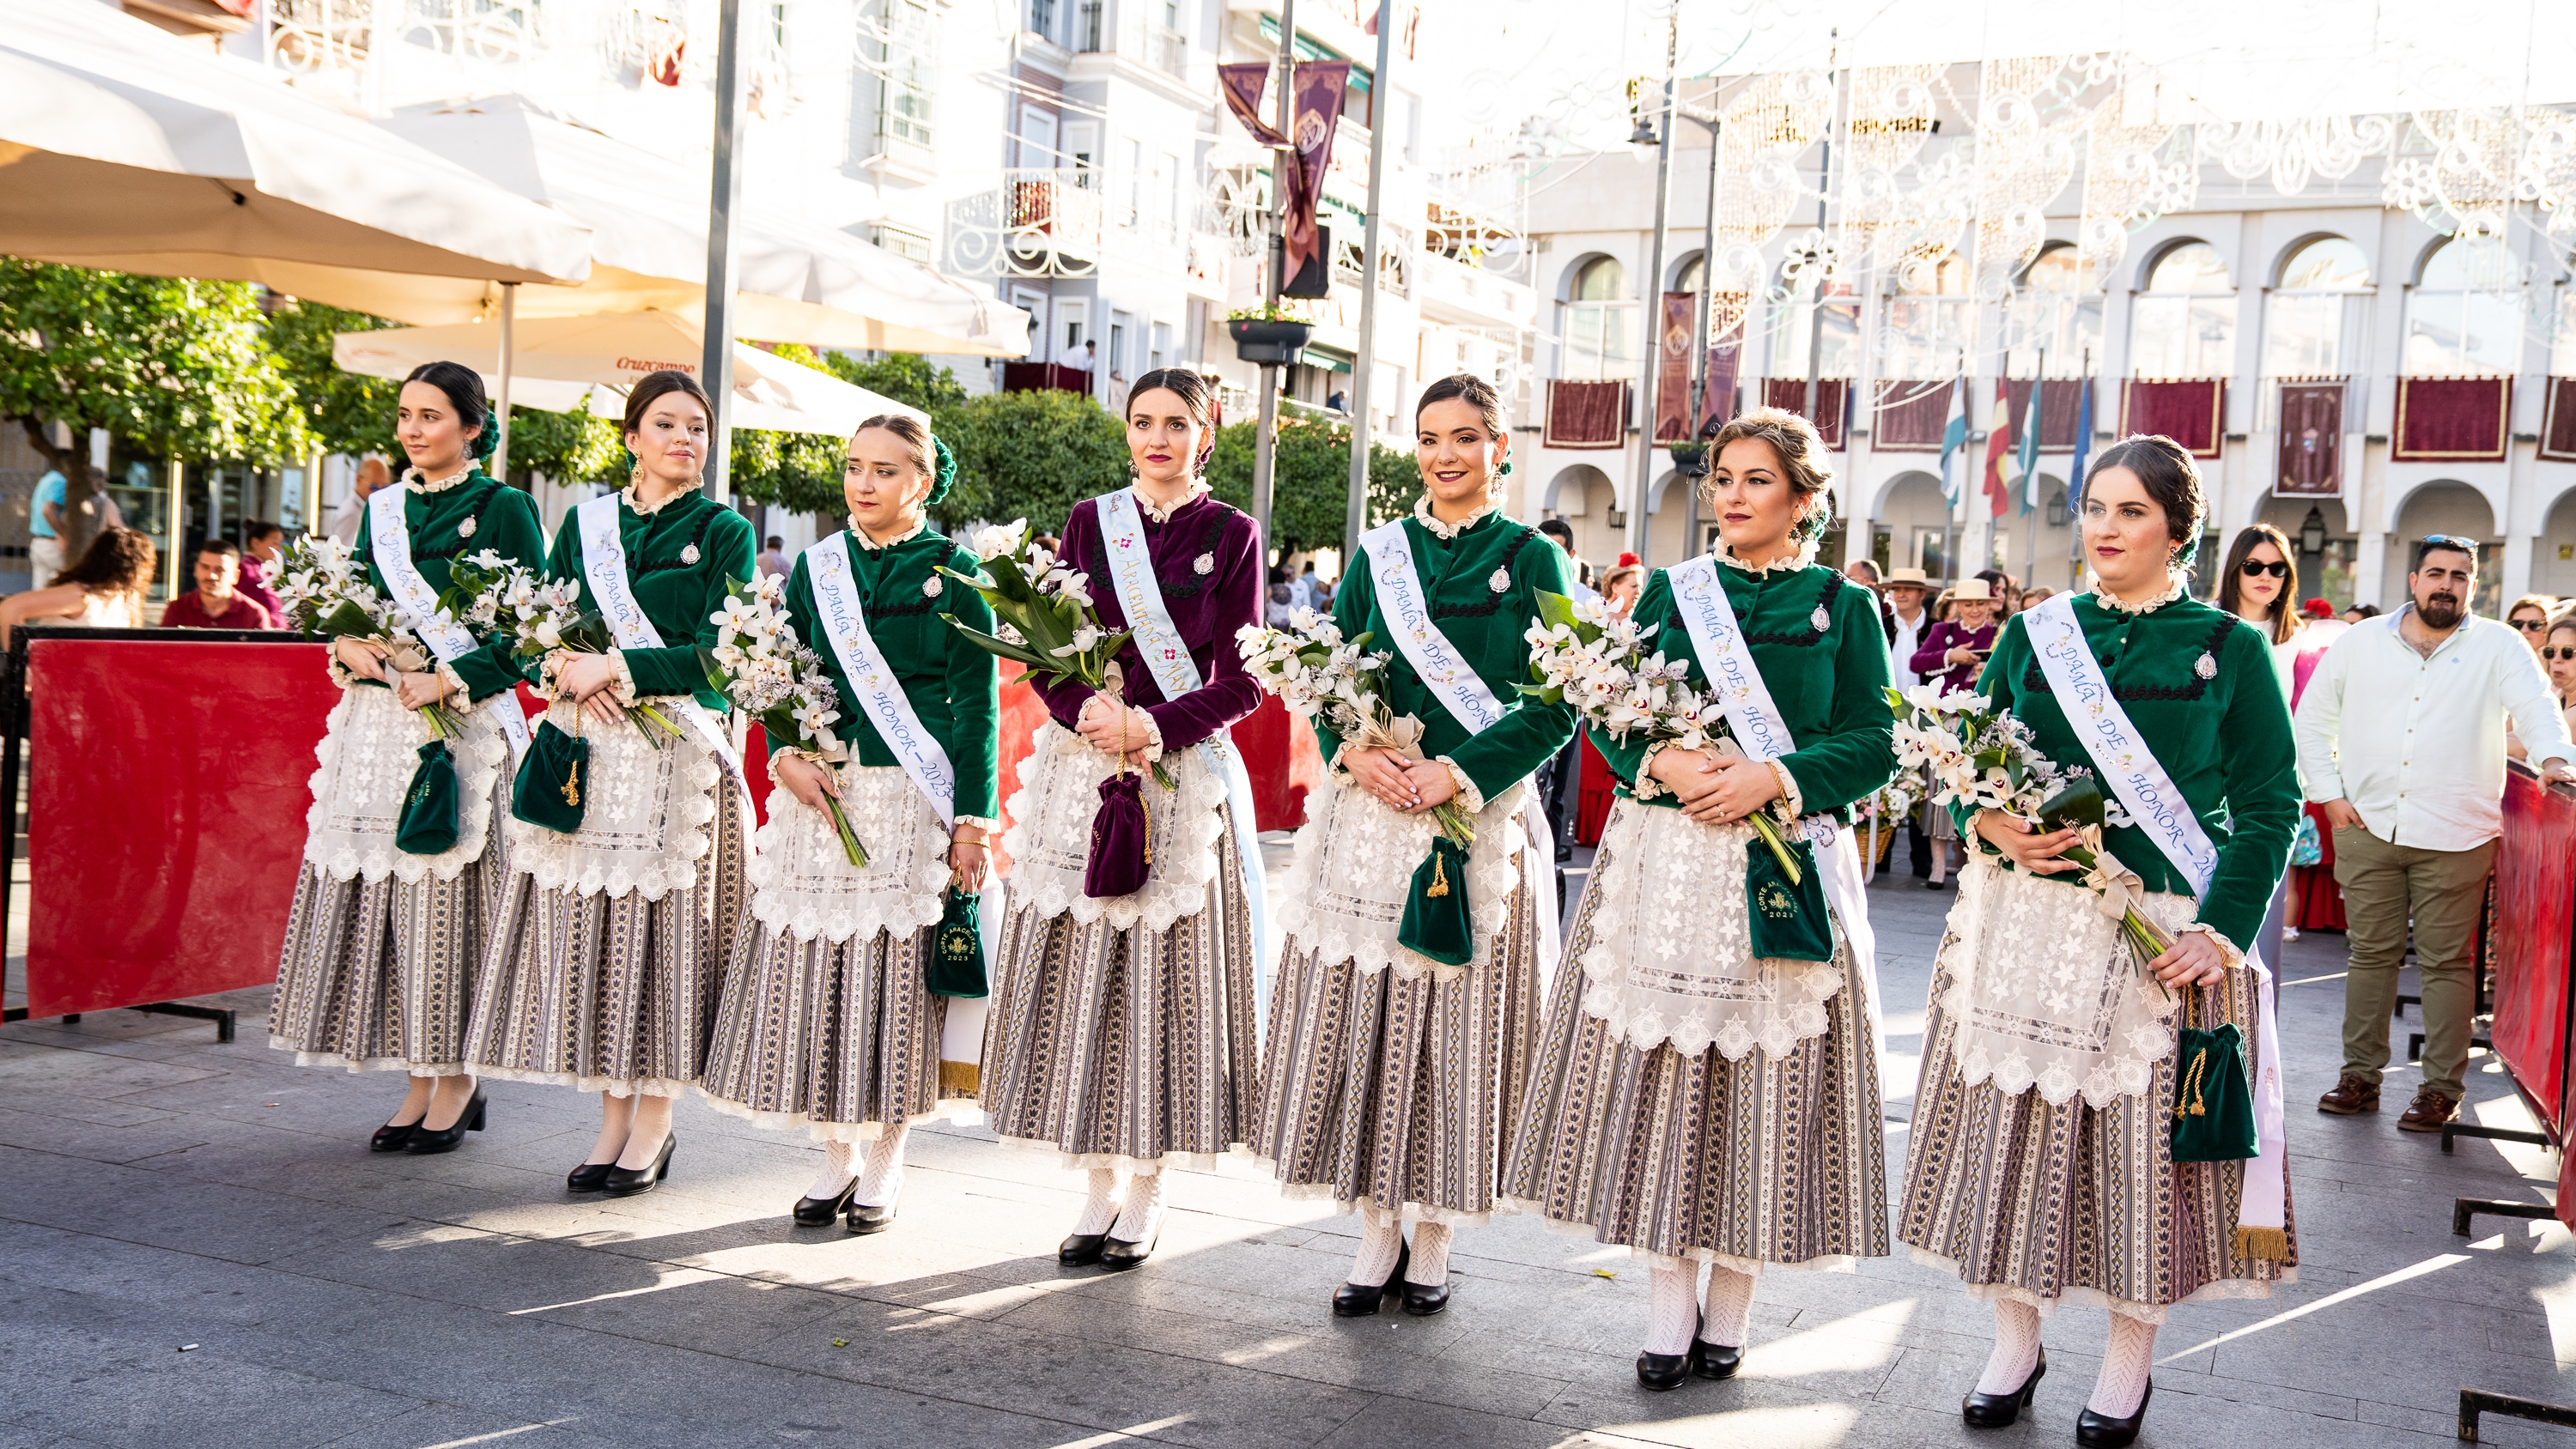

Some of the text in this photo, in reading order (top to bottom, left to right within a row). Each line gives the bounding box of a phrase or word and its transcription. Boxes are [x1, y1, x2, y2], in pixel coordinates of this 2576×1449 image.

[617, 356, 696, 373] Cruzcampo
[386, 539, 410, 587] DAMA
[416, 599, 441, 624] DE
[603, 570, 630, 622] DAMA
[1391, 578, 1418, 630] DAMA
[1423, 643, 1452, 670] DE
[1695, 594, 1726, 641] DAMA
[1720, 658, 1747, 688] DE
[825, 585, 851, 635] DAMA
[848, 648, 872, 675] DE
[873, 691, 917, 755] HONOR
[920, 762, 951, 797] 2023
[2061, 647, 2097, 704] DAMA
[2097, 718, 2129, 751] DE
[2128, 773, 2184, 850] HONOR
[940, 927, 976, 955] CORTE ARACELITANA
[1758, 887, 1768, 911] CORTE
